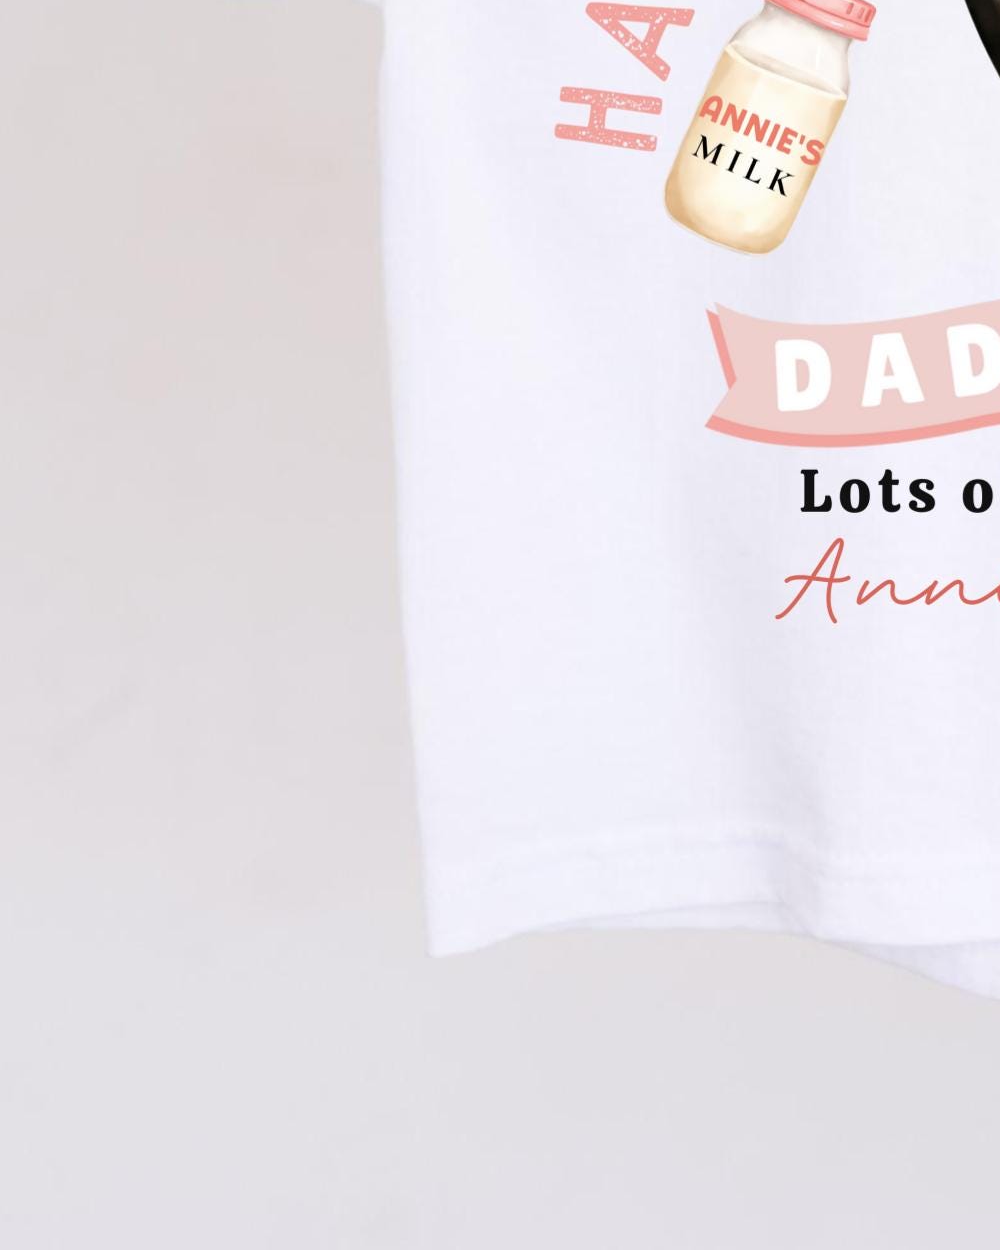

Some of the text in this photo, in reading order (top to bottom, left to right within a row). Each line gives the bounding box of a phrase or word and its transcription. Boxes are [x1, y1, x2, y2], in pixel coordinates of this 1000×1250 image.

[698, 95, 826, 167] ANNIE'S
[692, 134, 797, 198] MILK
[800, 468, 937, 514] Lots
